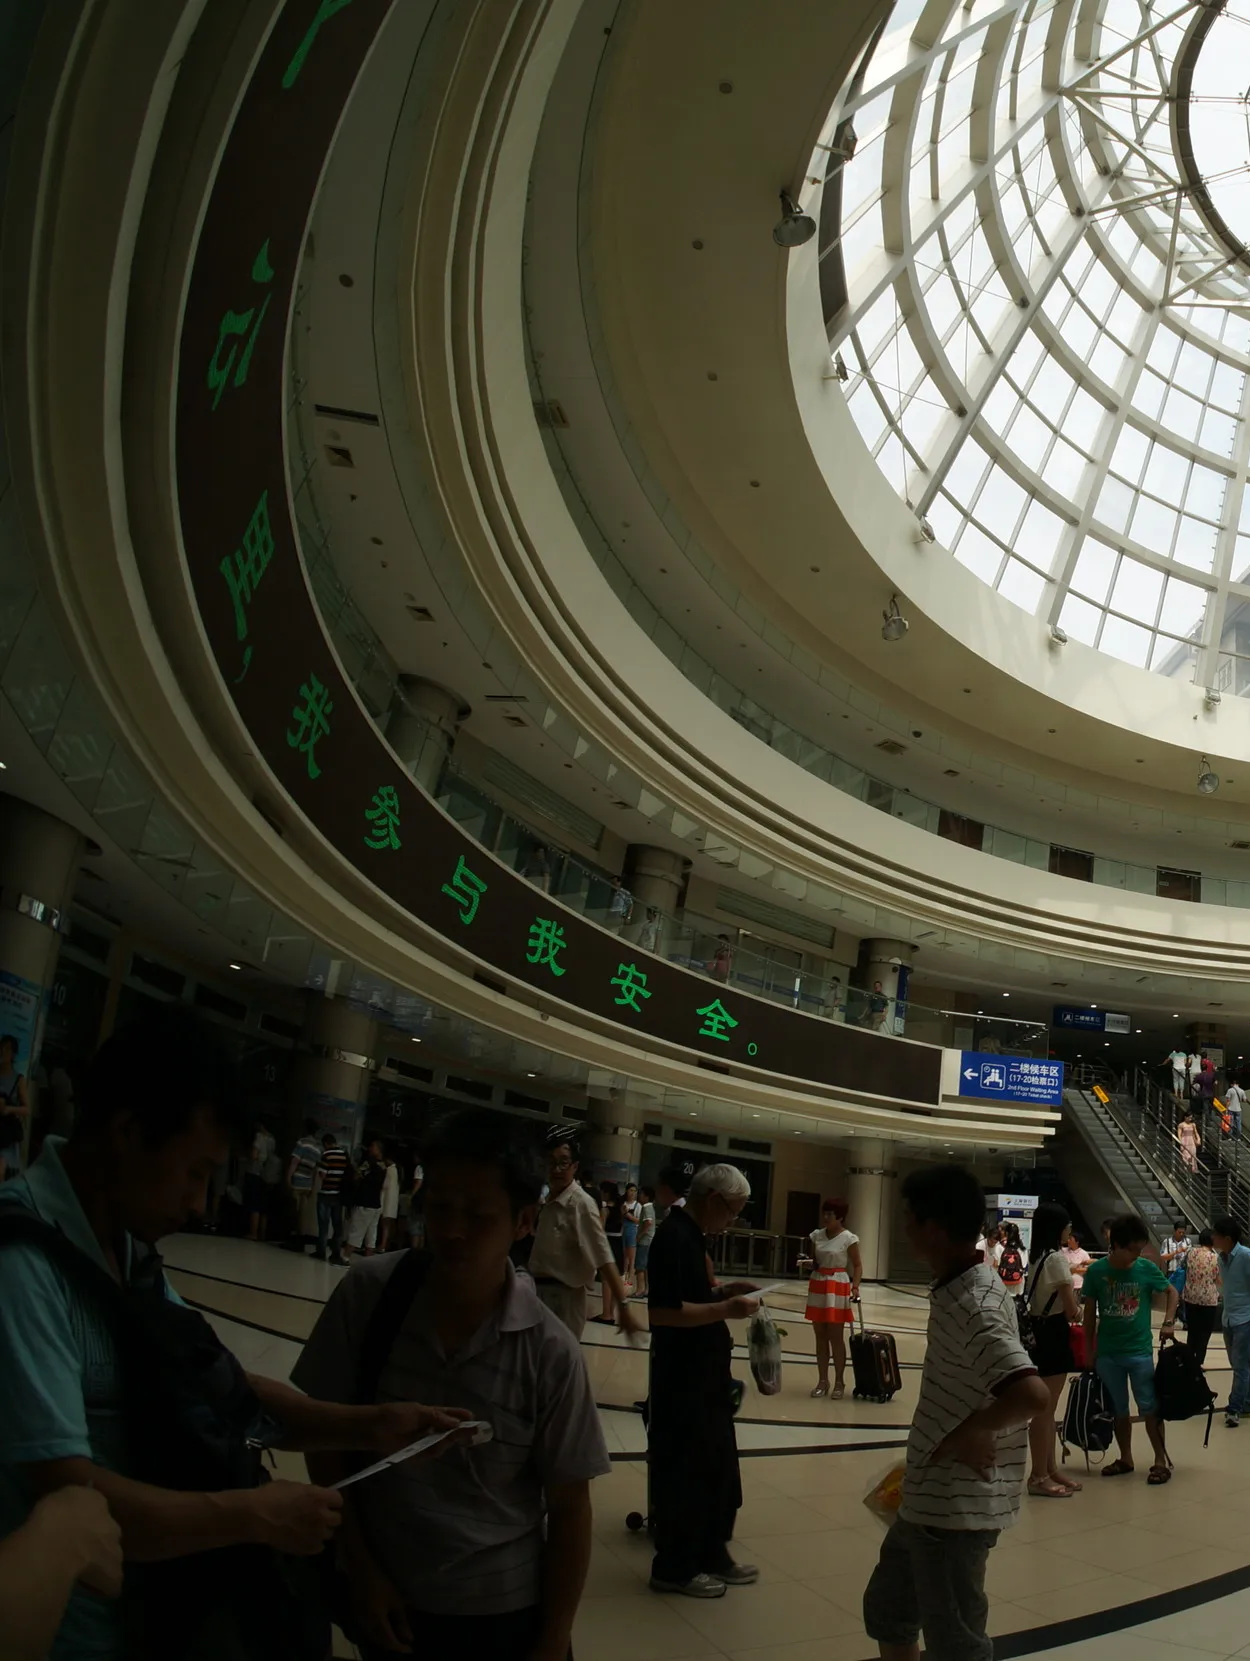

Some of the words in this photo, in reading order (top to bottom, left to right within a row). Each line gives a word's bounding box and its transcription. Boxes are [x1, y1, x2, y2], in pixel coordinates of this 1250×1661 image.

[1010, 1062, 1059, 1077] 二楼候车区
[1030, 1086, 1047, 1094] Waiting
[390, 1100, 403, 1118] 15
[683, 1162, 694, 1175] 20
